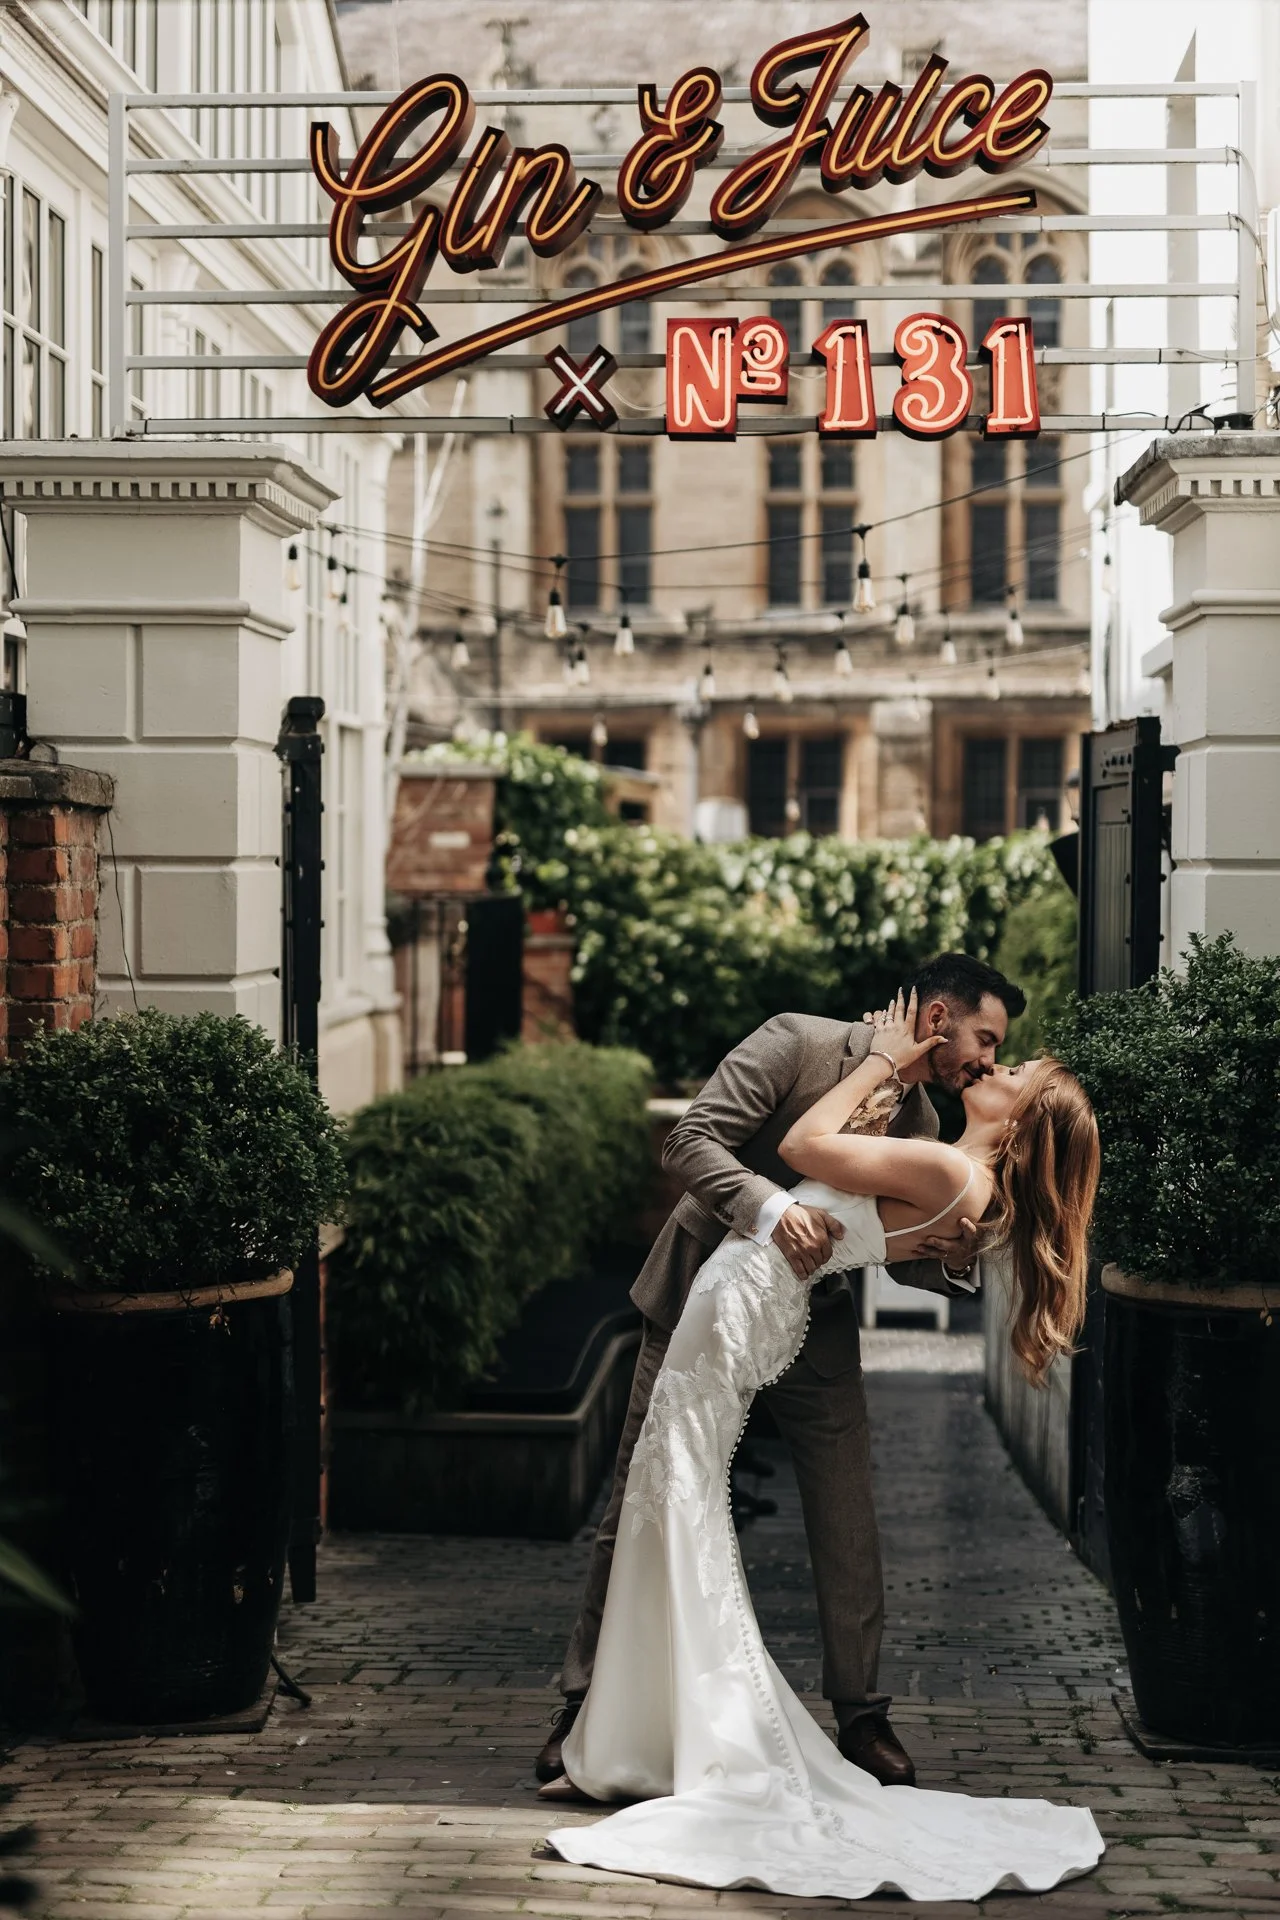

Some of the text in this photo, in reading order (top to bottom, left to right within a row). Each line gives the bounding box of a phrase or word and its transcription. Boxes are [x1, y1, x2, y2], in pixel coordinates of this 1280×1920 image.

[307, 13, 1053, 407] Gin & Juice
[812, 313, 1040, 440] 131
